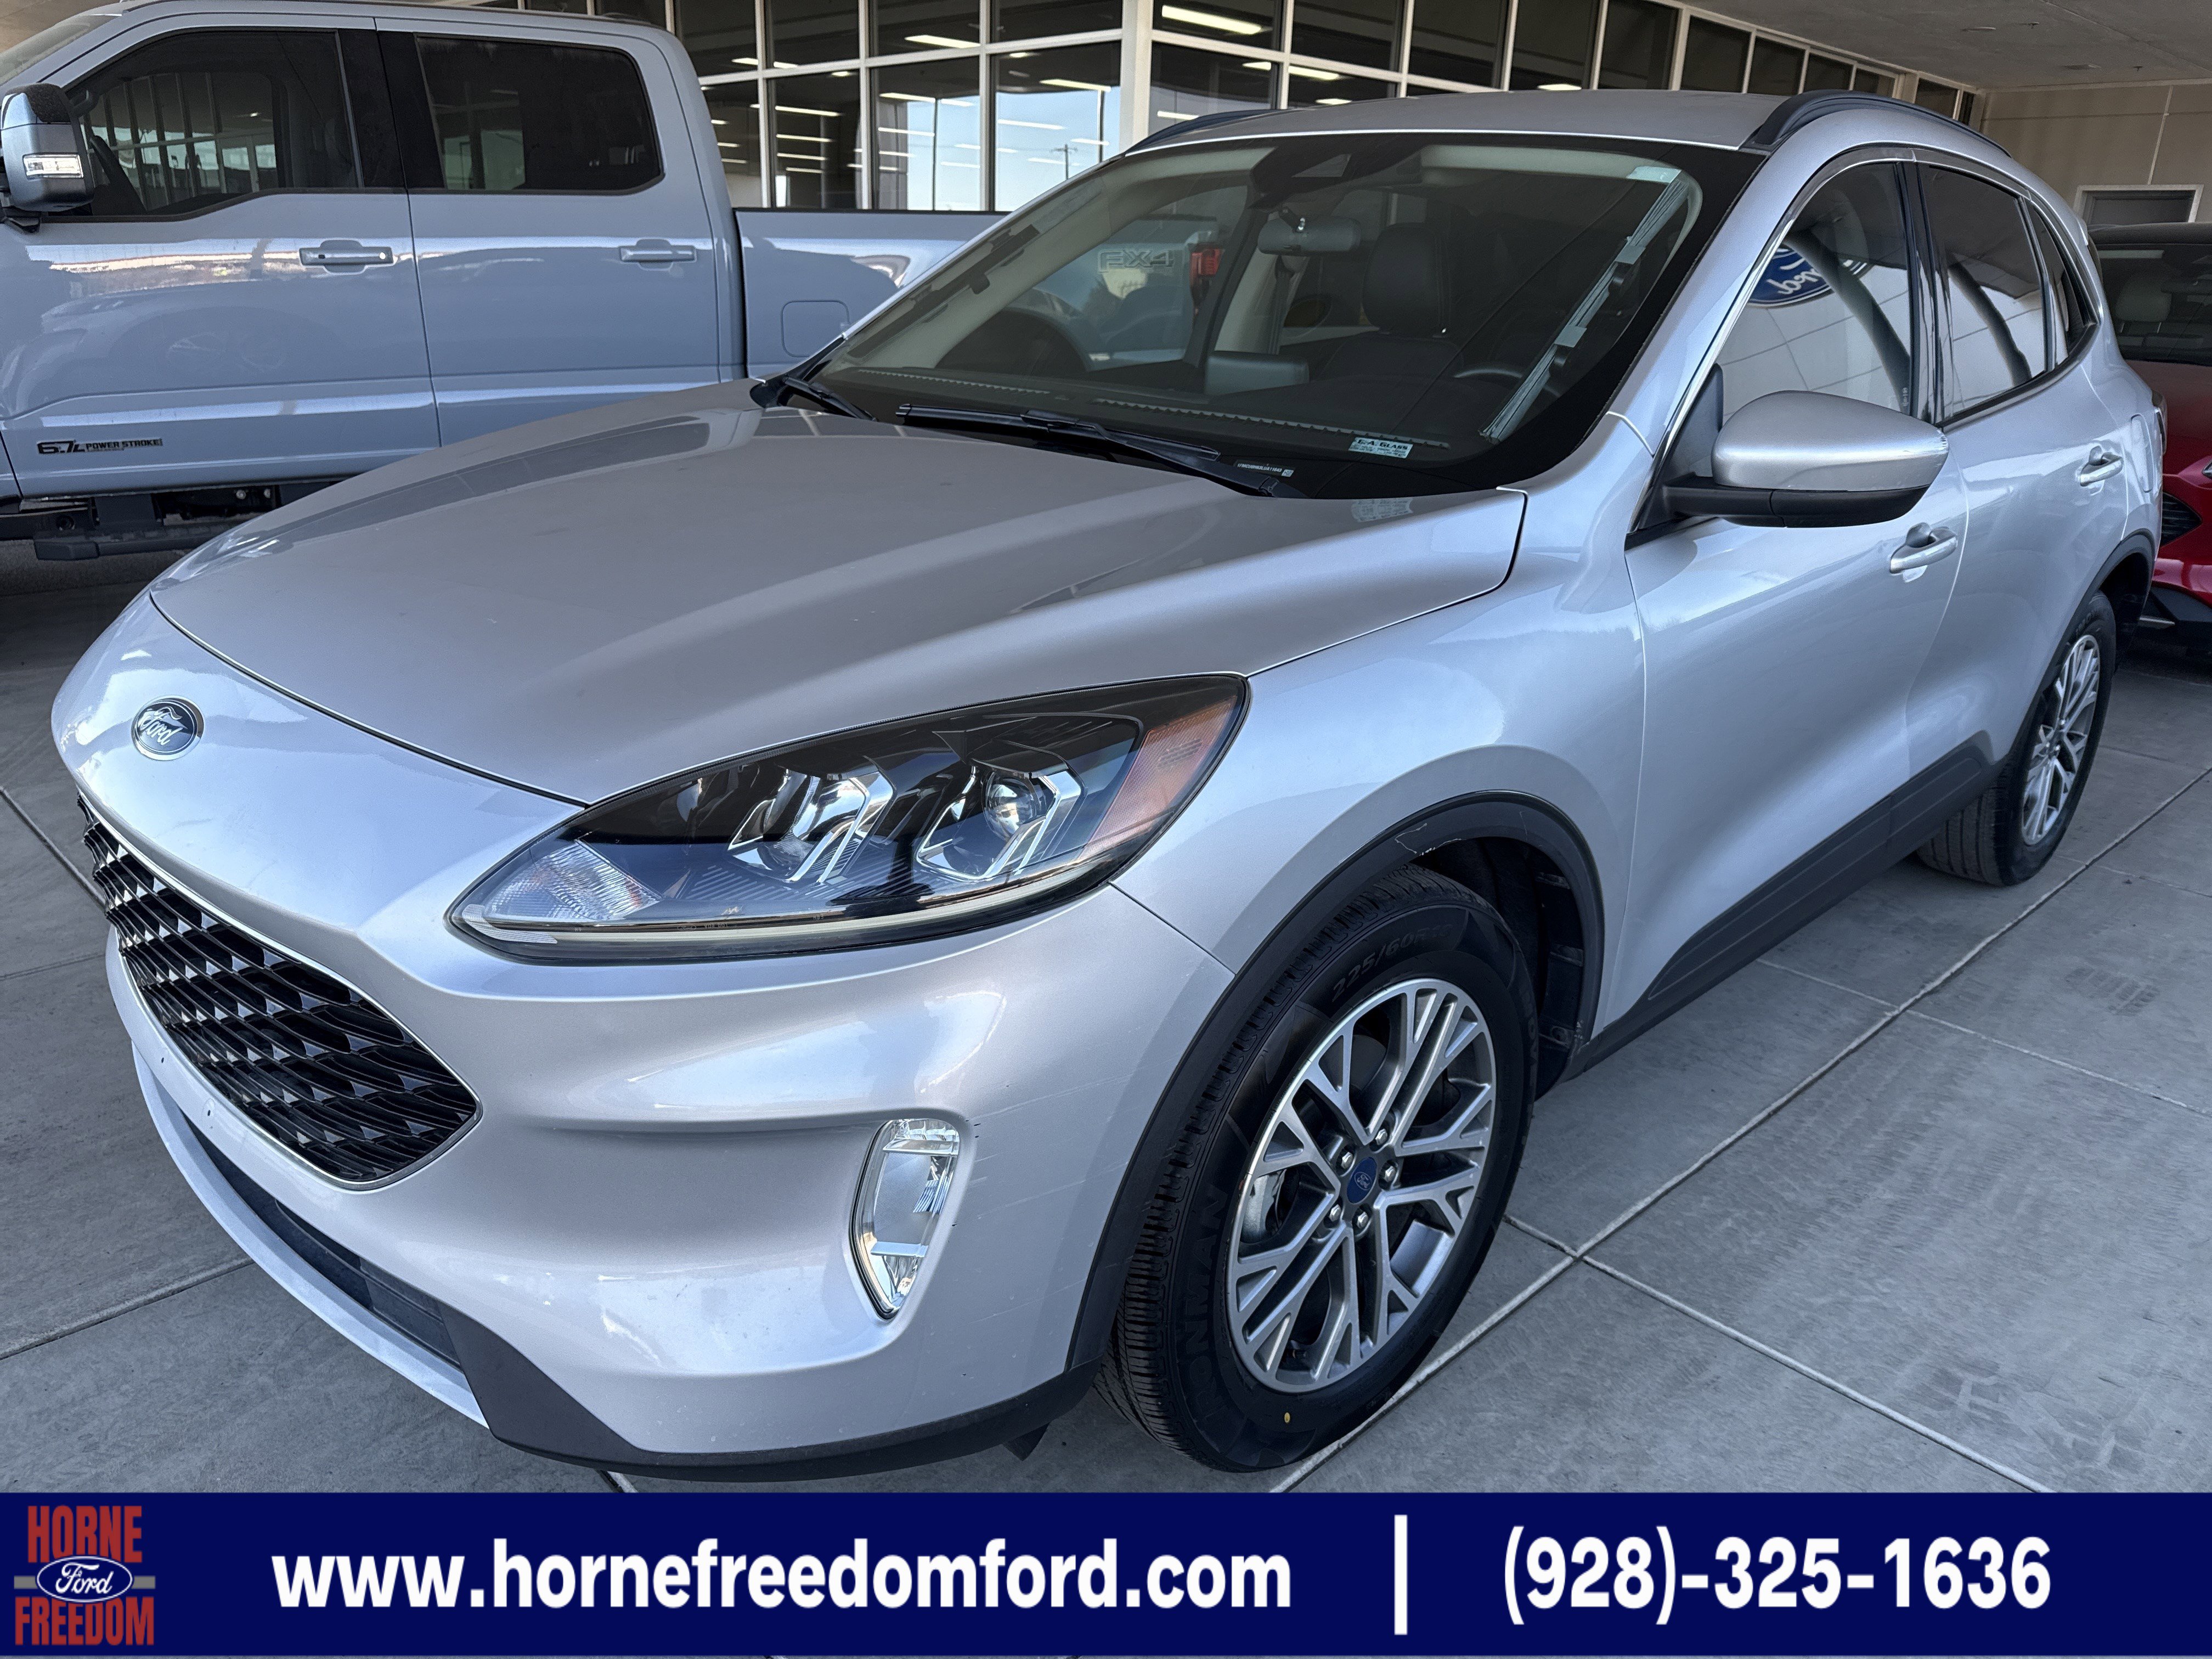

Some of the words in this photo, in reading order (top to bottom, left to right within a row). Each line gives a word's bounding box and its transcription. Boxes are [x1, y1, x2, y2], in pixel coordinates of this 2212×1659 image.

[1098, 250, 1175, 274] FX4
[37, 440, 85, 454] 6.7L
[86, 441, 120, 450] POWER
[121, 438, 159, 448] STROKE
[138, 706, 183, 746] Ford
[1357, 1173, 1370, 1189] Ford
